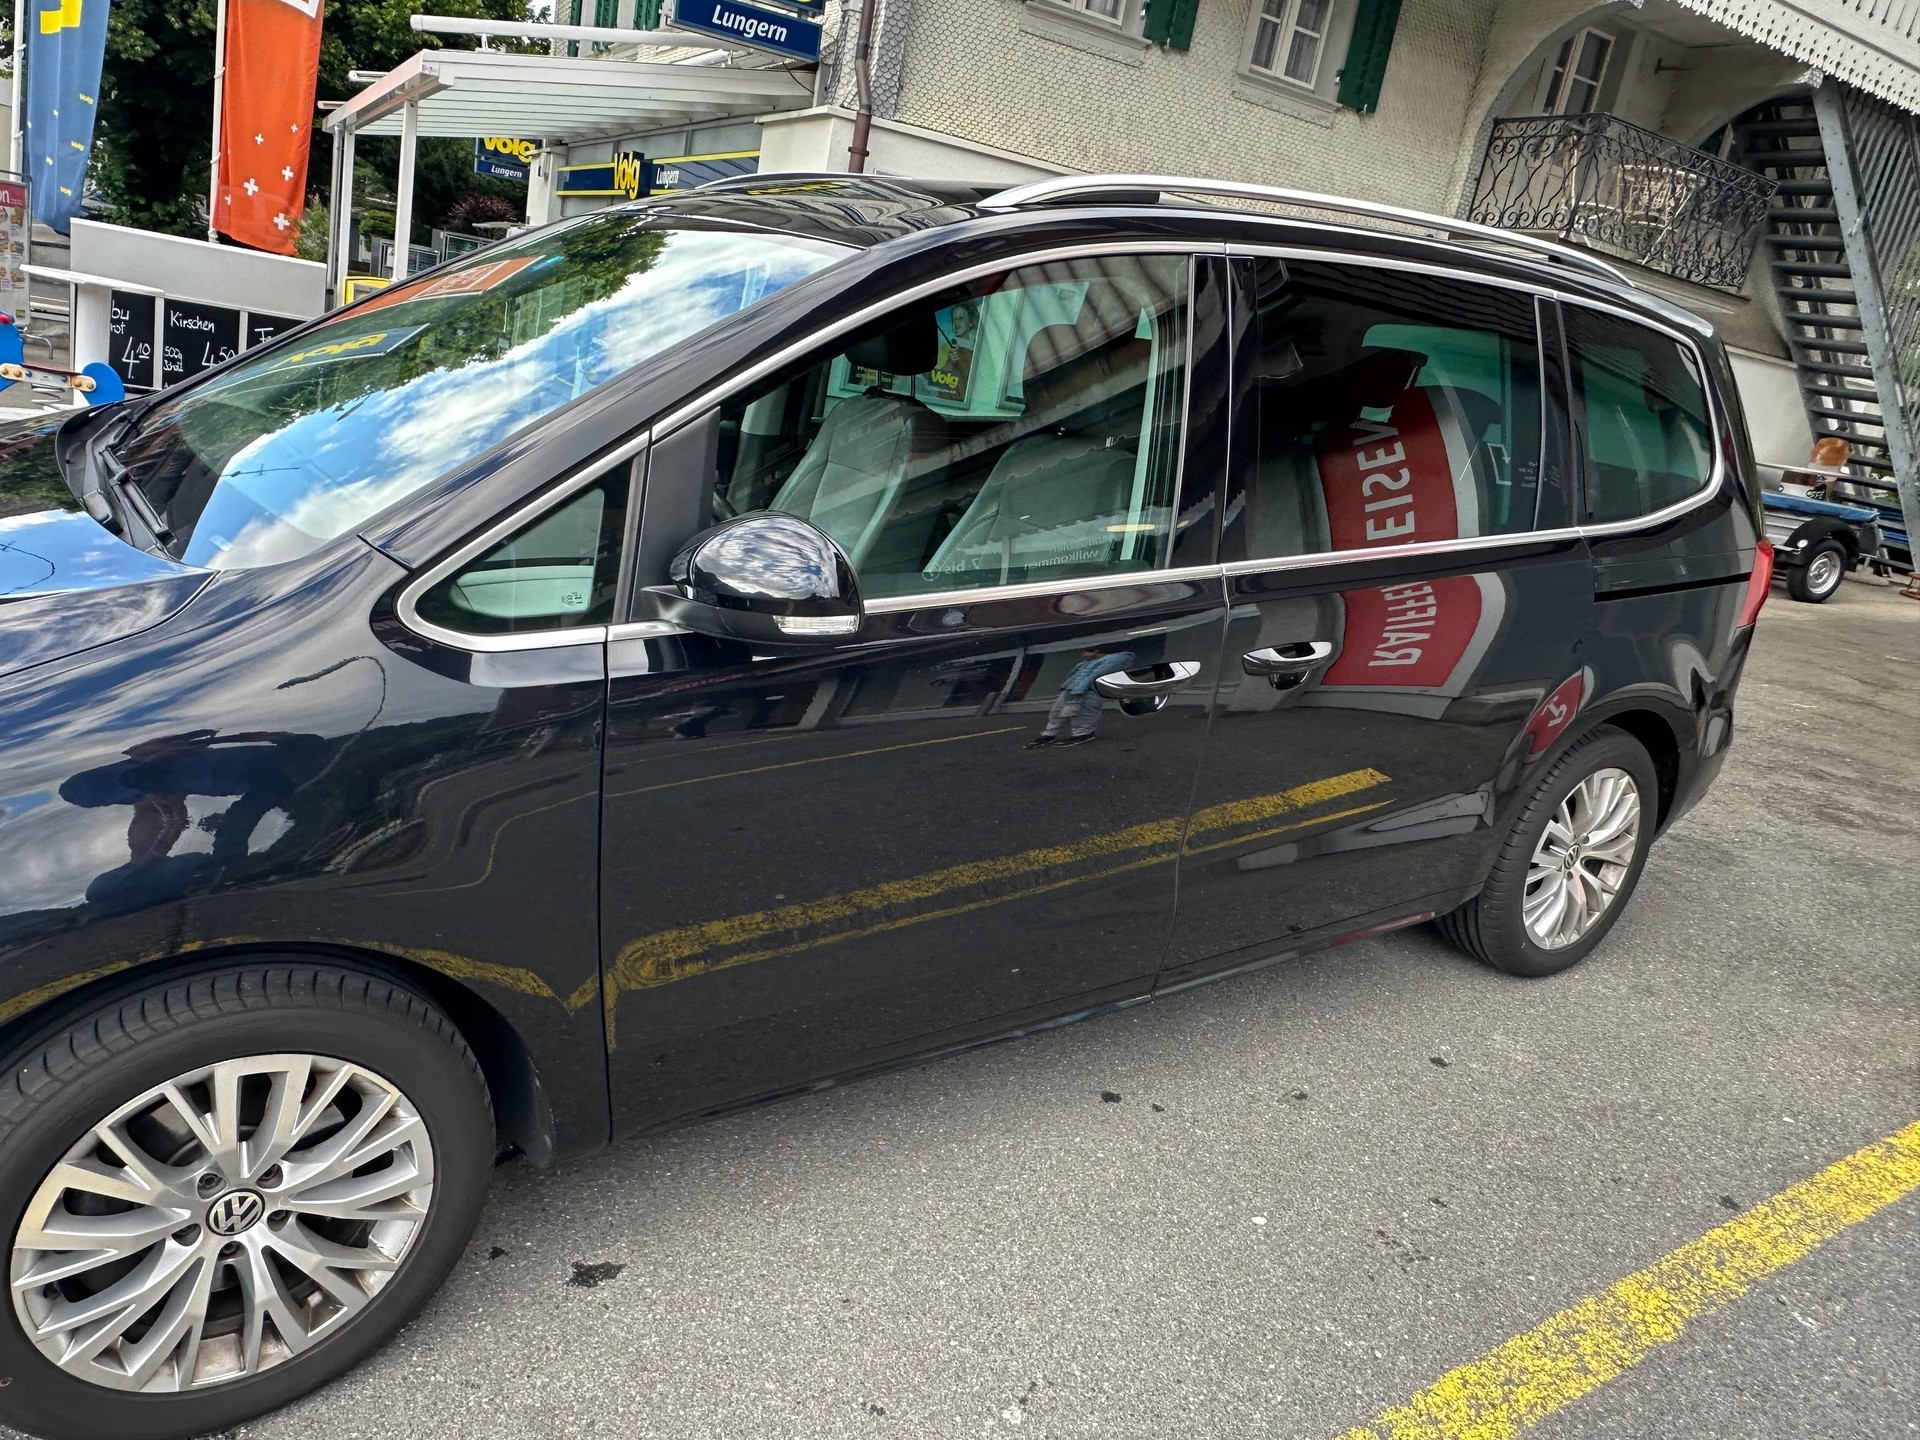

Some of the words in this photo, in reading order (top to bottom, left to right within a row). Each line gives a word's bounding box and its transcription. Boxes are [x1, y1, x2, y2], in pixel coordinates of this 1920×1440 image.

[712, 4, 788, 42] Lungern
[491, 165, 523, 178] Lungern
[614, 151, 641, 200] Volg
[656, 167, 680, 189] Lungern
[170, 309, 216, 333] Kirschen
[931, 369, 959, 388] Volg
